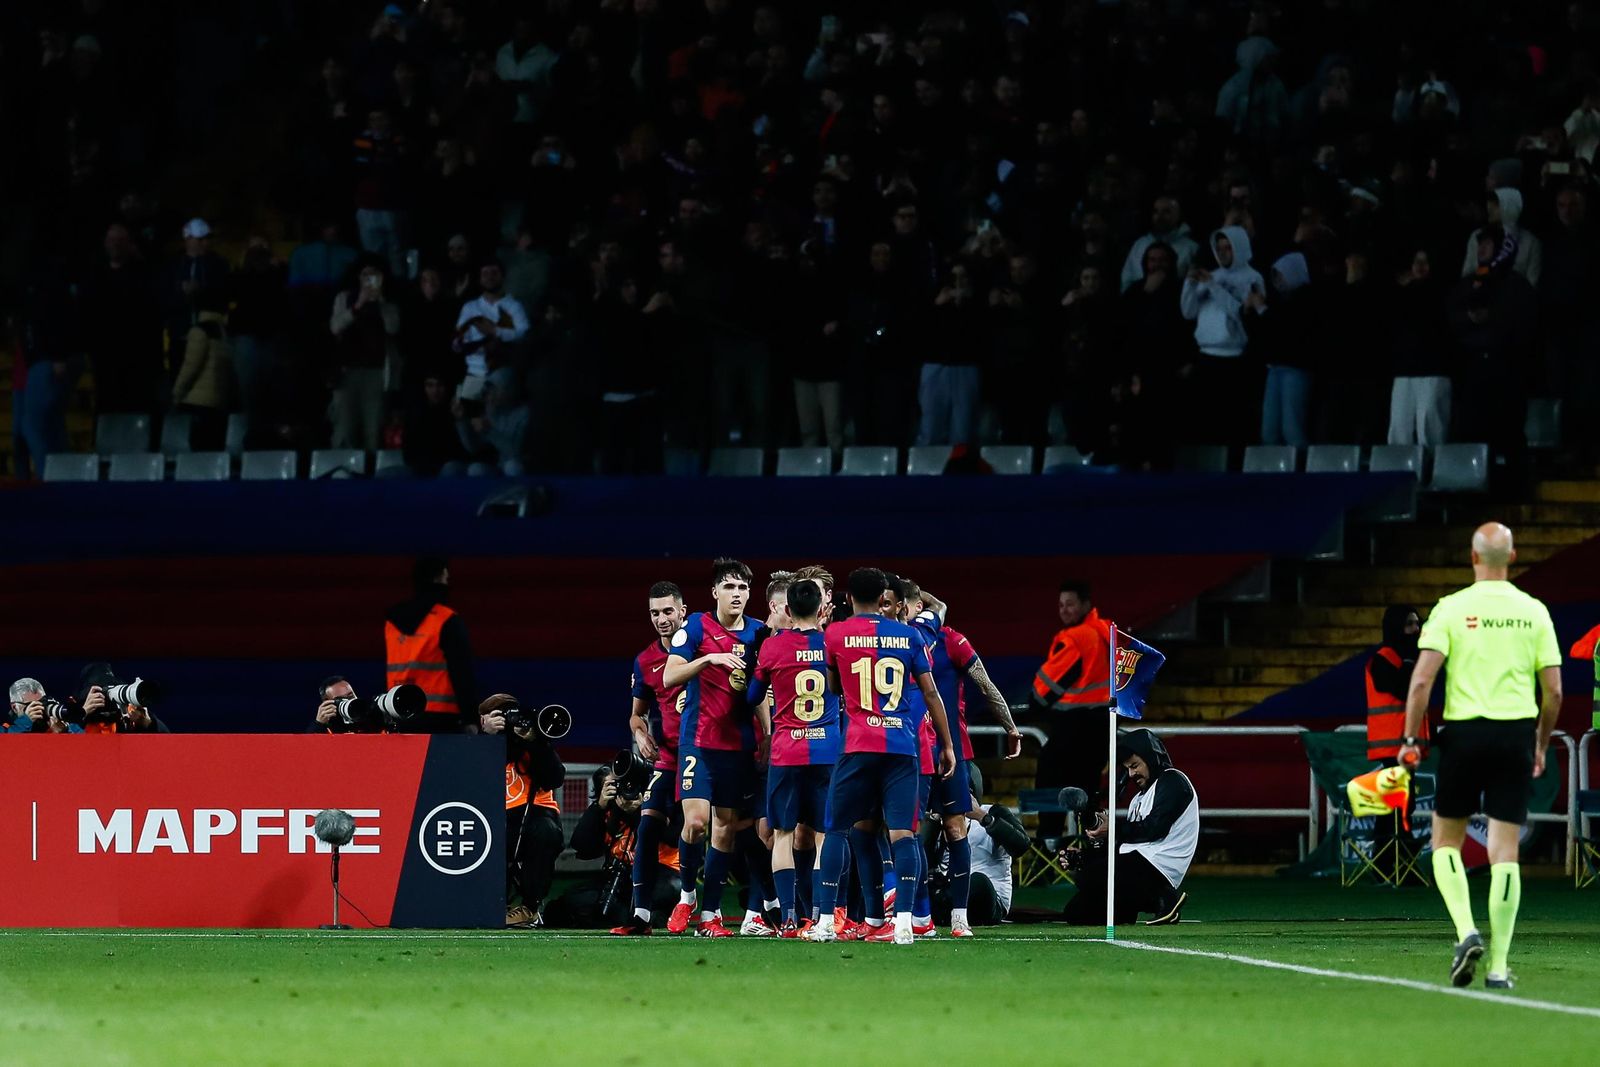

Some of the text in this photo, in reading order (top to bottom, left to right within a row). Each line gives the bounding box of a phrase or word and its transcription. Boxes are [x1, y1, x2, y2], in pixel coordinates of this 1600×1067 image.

[844, 636, 910, 649] LAMINE YAMAL
[796, 650, 824, 662] PEDRI
[794, 669, 825, 721] 8
[851, 657, 905, 711] 19
[683, 755, 697, 777] 2
[647, 770, 663, 790] 7
[78, 808, 381, 854] MAPFRE
